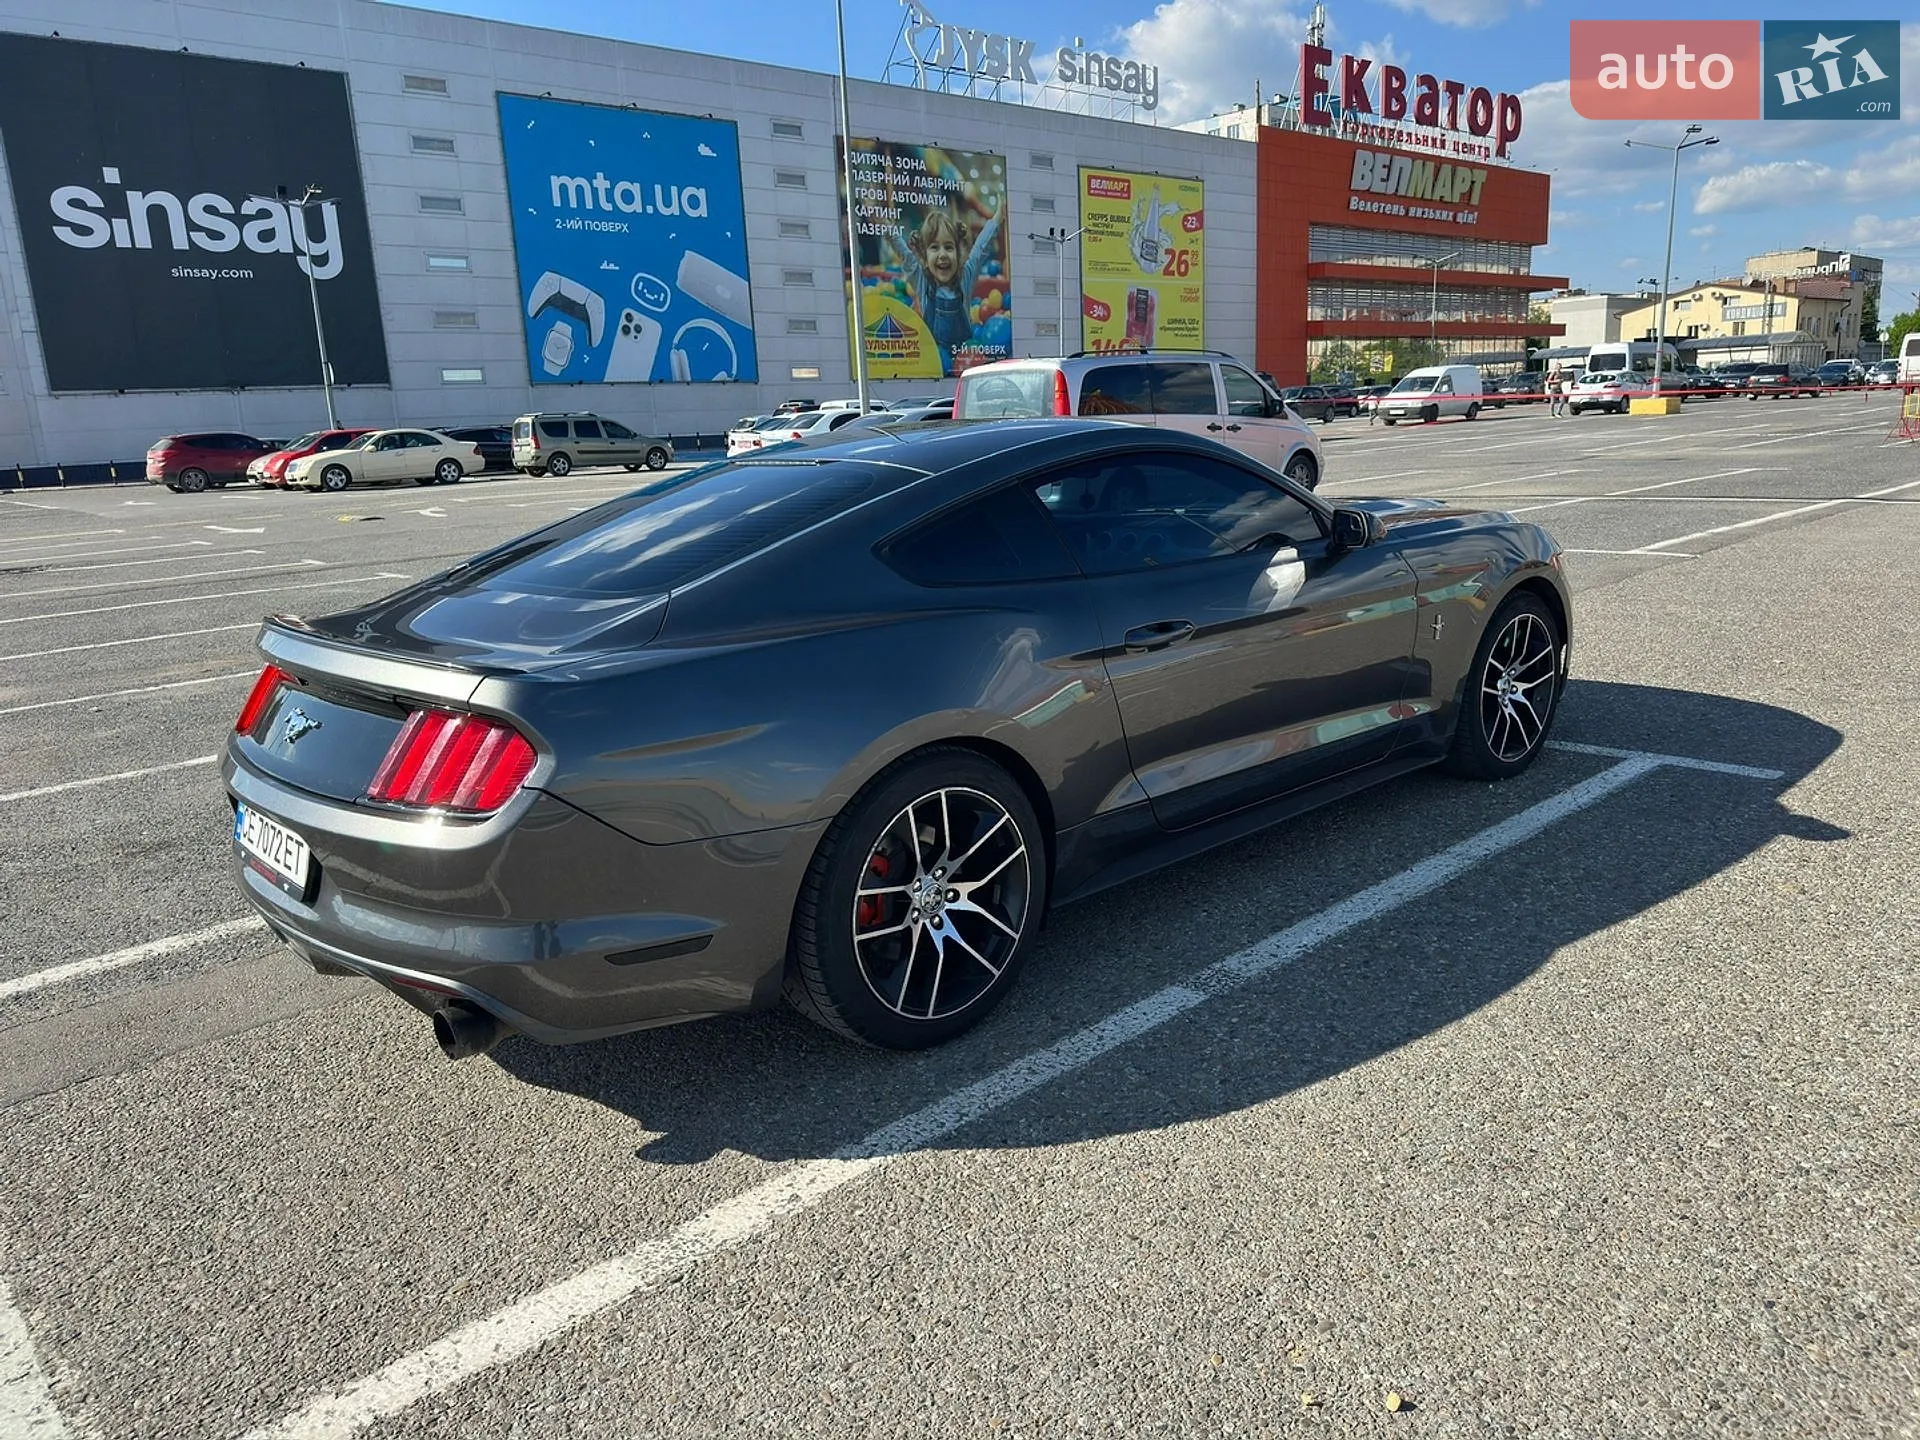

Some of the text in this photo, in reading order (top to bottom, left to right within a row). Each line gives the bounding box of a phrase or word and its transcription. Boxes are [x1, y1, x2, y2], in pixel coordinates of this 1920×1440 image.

[934, 23, 1038, 85] JYSK
[1057, 36, 1159, 110] sinsay
[1300, 43, 1522, 158] Екватор
[896, 157, 926, 171] ЗОНА
[1453, 140, 1490, 161] центр
[1350, 149, 1488, 206] ВЕЛМАРТ
[550, 172, 708, 218] mta.ua
[855, 187, 947, 206] ГРОВІ АВТОМАТИ
[1349, 196, 1405, 216] Велетень
[1408, 206, 1453, 221] низьких
[50, 166, 344, 280] sinsay
[555, 218, 629, 233] 2-ИЙ ПОВЕРХ
[171, 266, 254, 281] sinsay.com
[1163, 247, 1189, 277] 26
[865, 339, 920, 351] УЛЬТІПАРК
[971, 344, 1006, 355] ПОВЕРХ
[256, 817, 283, 864] 7072
[284, 834, 304, 875] ET
